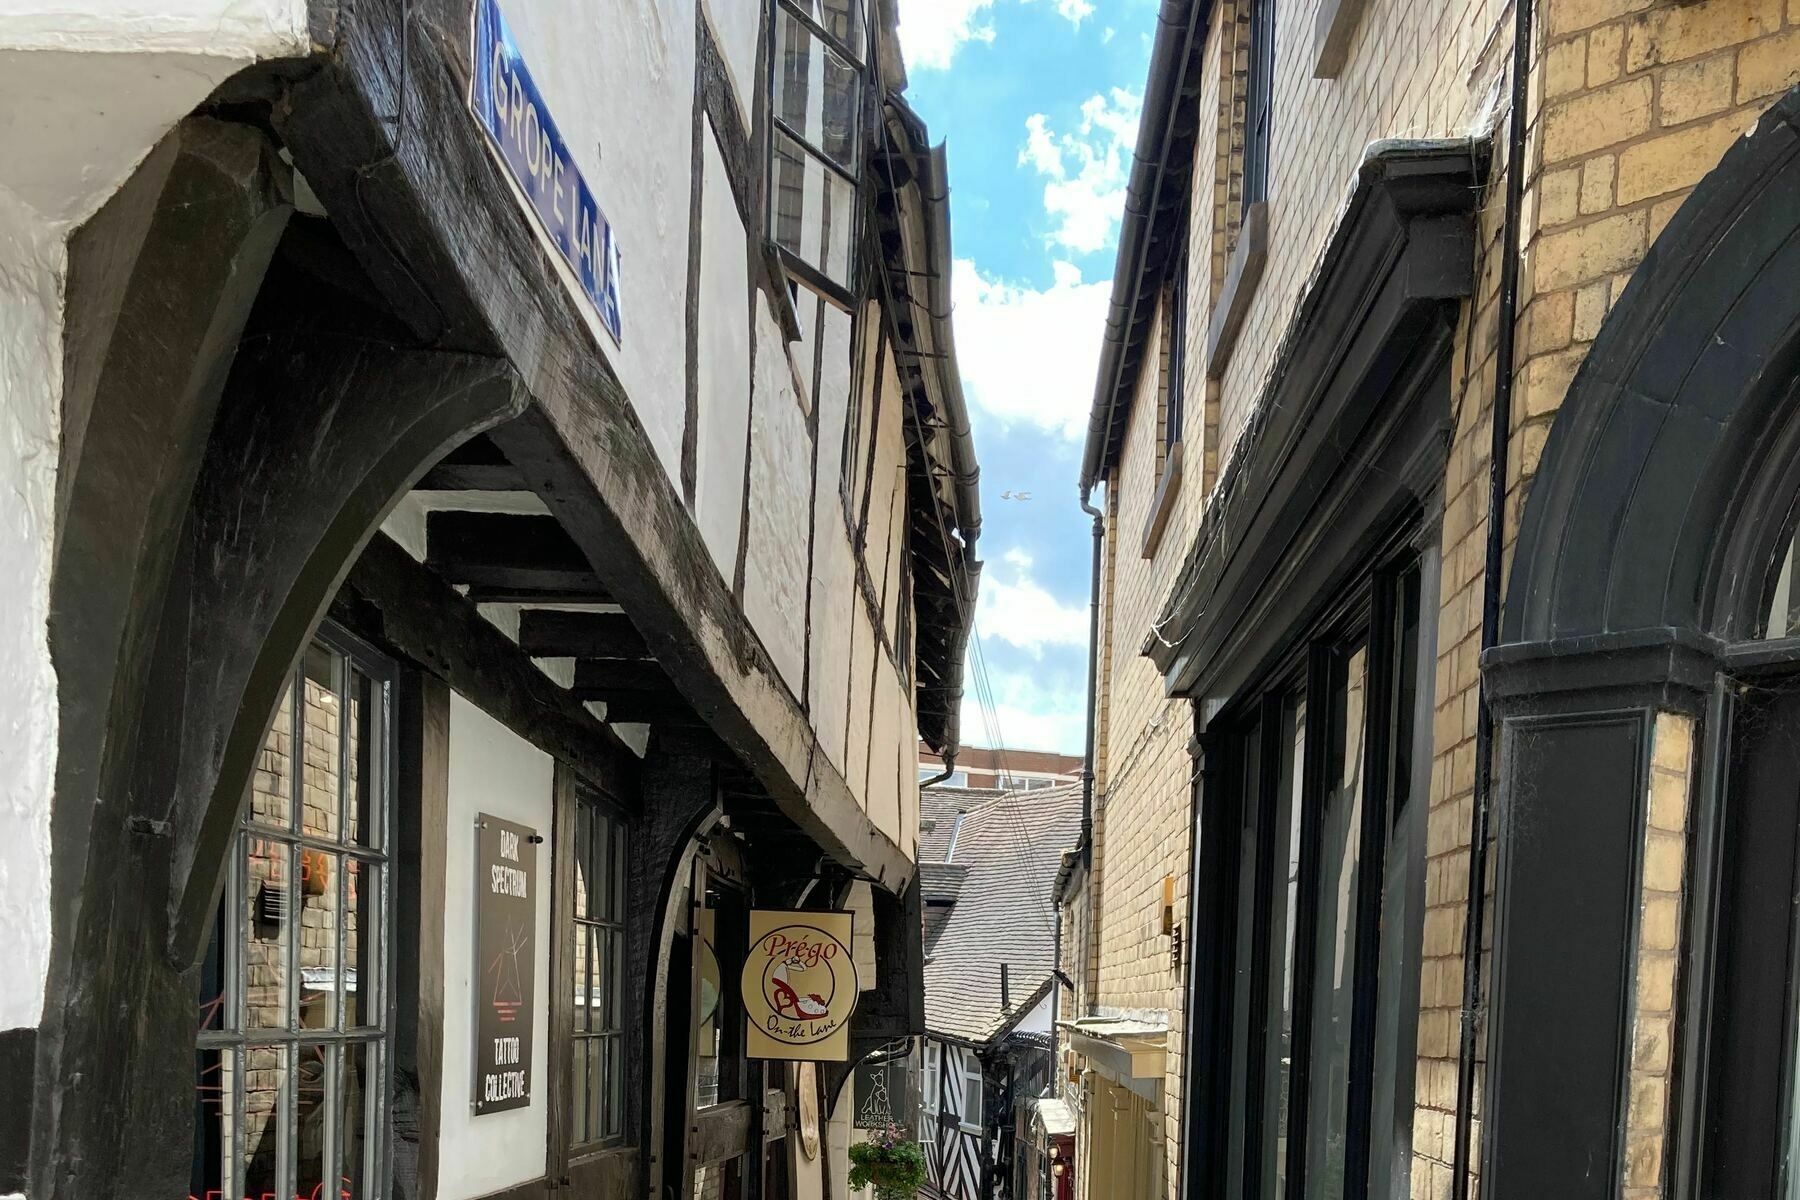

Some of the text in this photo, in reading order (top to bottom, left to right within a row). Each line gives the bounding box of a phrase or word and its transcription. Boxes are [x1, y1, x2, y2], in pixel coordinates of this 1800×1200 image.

[491, 40, 565, 224] GROPE
[500, 829, 519, 862] DARK
[491, 864, 527, 899] SPECTRUM
[763, 934, 838, 968] Prégo
[810, 1019, 837, 1037] Lane
[494, 1036, 520, 1066] TATTOO
[485, 1070, 525, 1102] COLLECTIVE
[861, 1114, 894, 1122] LEATHER
